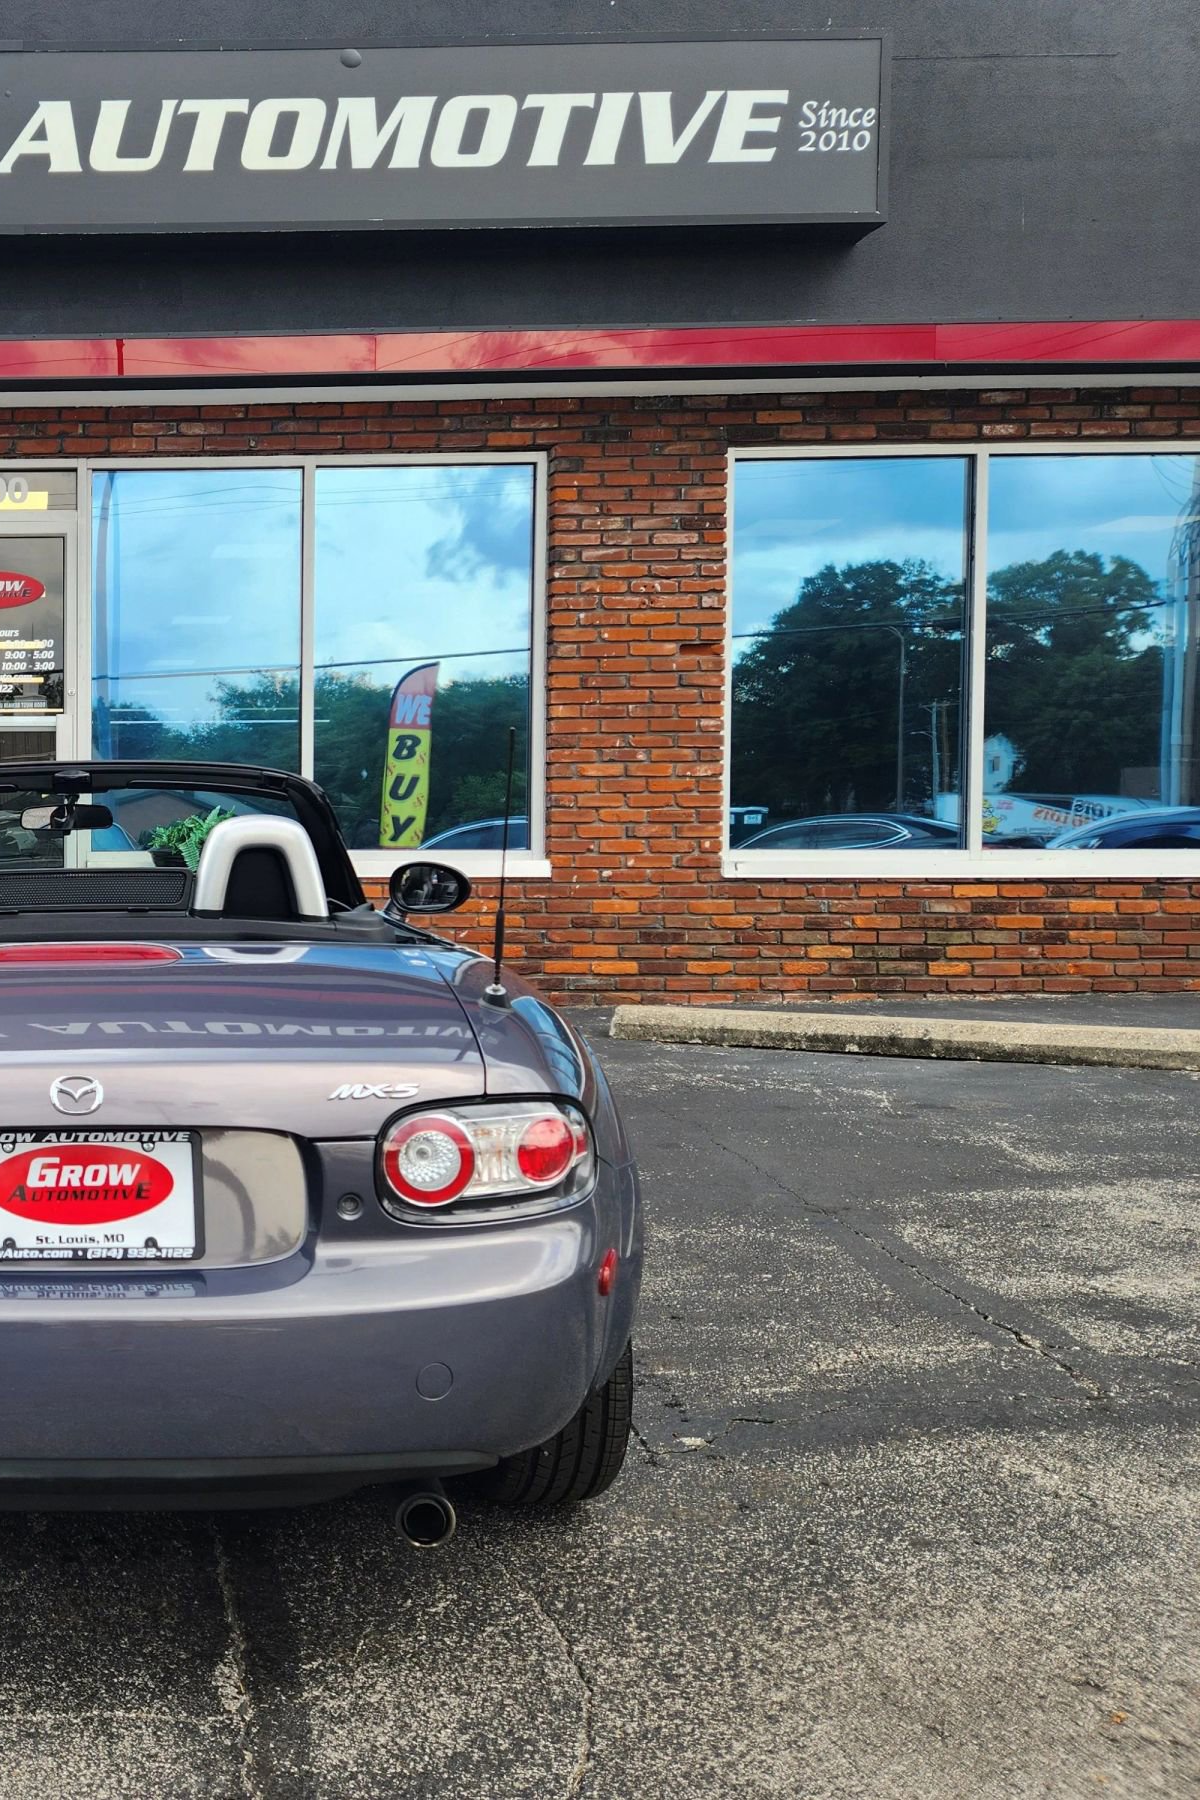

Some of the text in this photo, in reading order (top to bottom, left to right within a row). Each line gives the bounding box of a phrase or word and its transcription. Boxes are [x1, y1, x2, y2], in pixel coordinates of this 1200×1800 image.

[798, 100, 876, 128] Since
[798, 130, 871, 152] 2010
[5, 650, 26, 660] 9:00
[33, 650, 55, 660] 5:00
[2, 661, 27, 671] 10:00
[34, 661, 55, 670] 3:00
[395, 694, 433, 726] WE
[388, 734, 423, 843] BUY
[328, 1083, 420, 1101] MX-5
[41, 1131, 191, 1143] AUTOMOTIVE
[35, 1233, 125, 1245] St. Louis, MO
[86, 1248, 123, 1259] (314)
[127, 1248, 194, 1259] 932-1122
